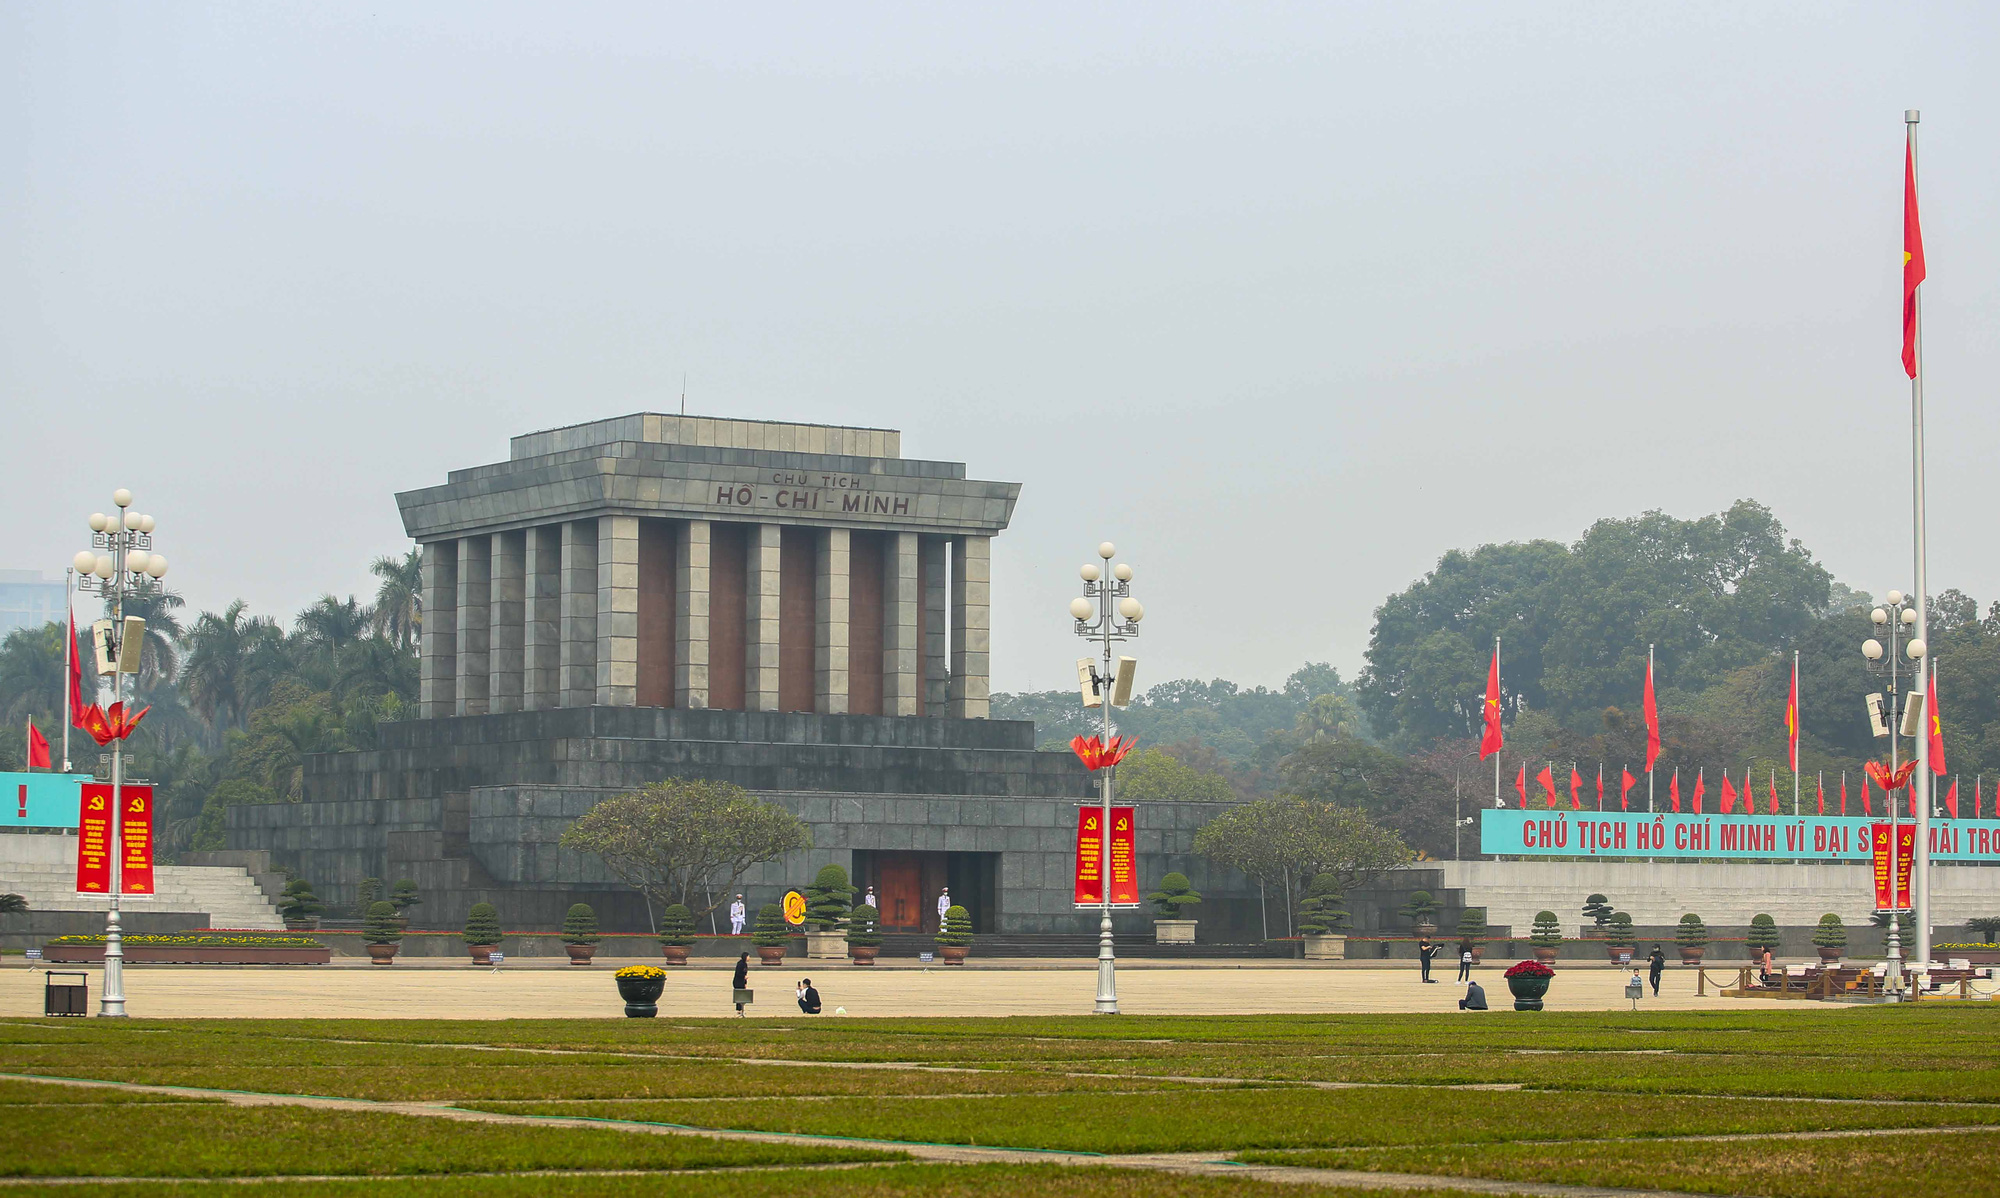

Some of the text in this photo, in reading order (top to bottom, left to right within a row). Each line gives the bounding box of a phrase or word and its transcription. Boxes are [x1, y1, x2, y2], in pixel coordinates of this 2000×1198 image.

[775, 487, 821, 510] CHÍ
[1523, 812, 1567, 848] CHỦ
[1577, 821, 1627, 854] TỊCH
[1636, 814, 1665, 850] HỒ
[1675, 817, 1711, 850] CHÍ
[1720, 823, 1776, 851] MINH
[1785, 819, 1806, 852] VĨ
[1814, 825, 1849, 857] ĐẠI
